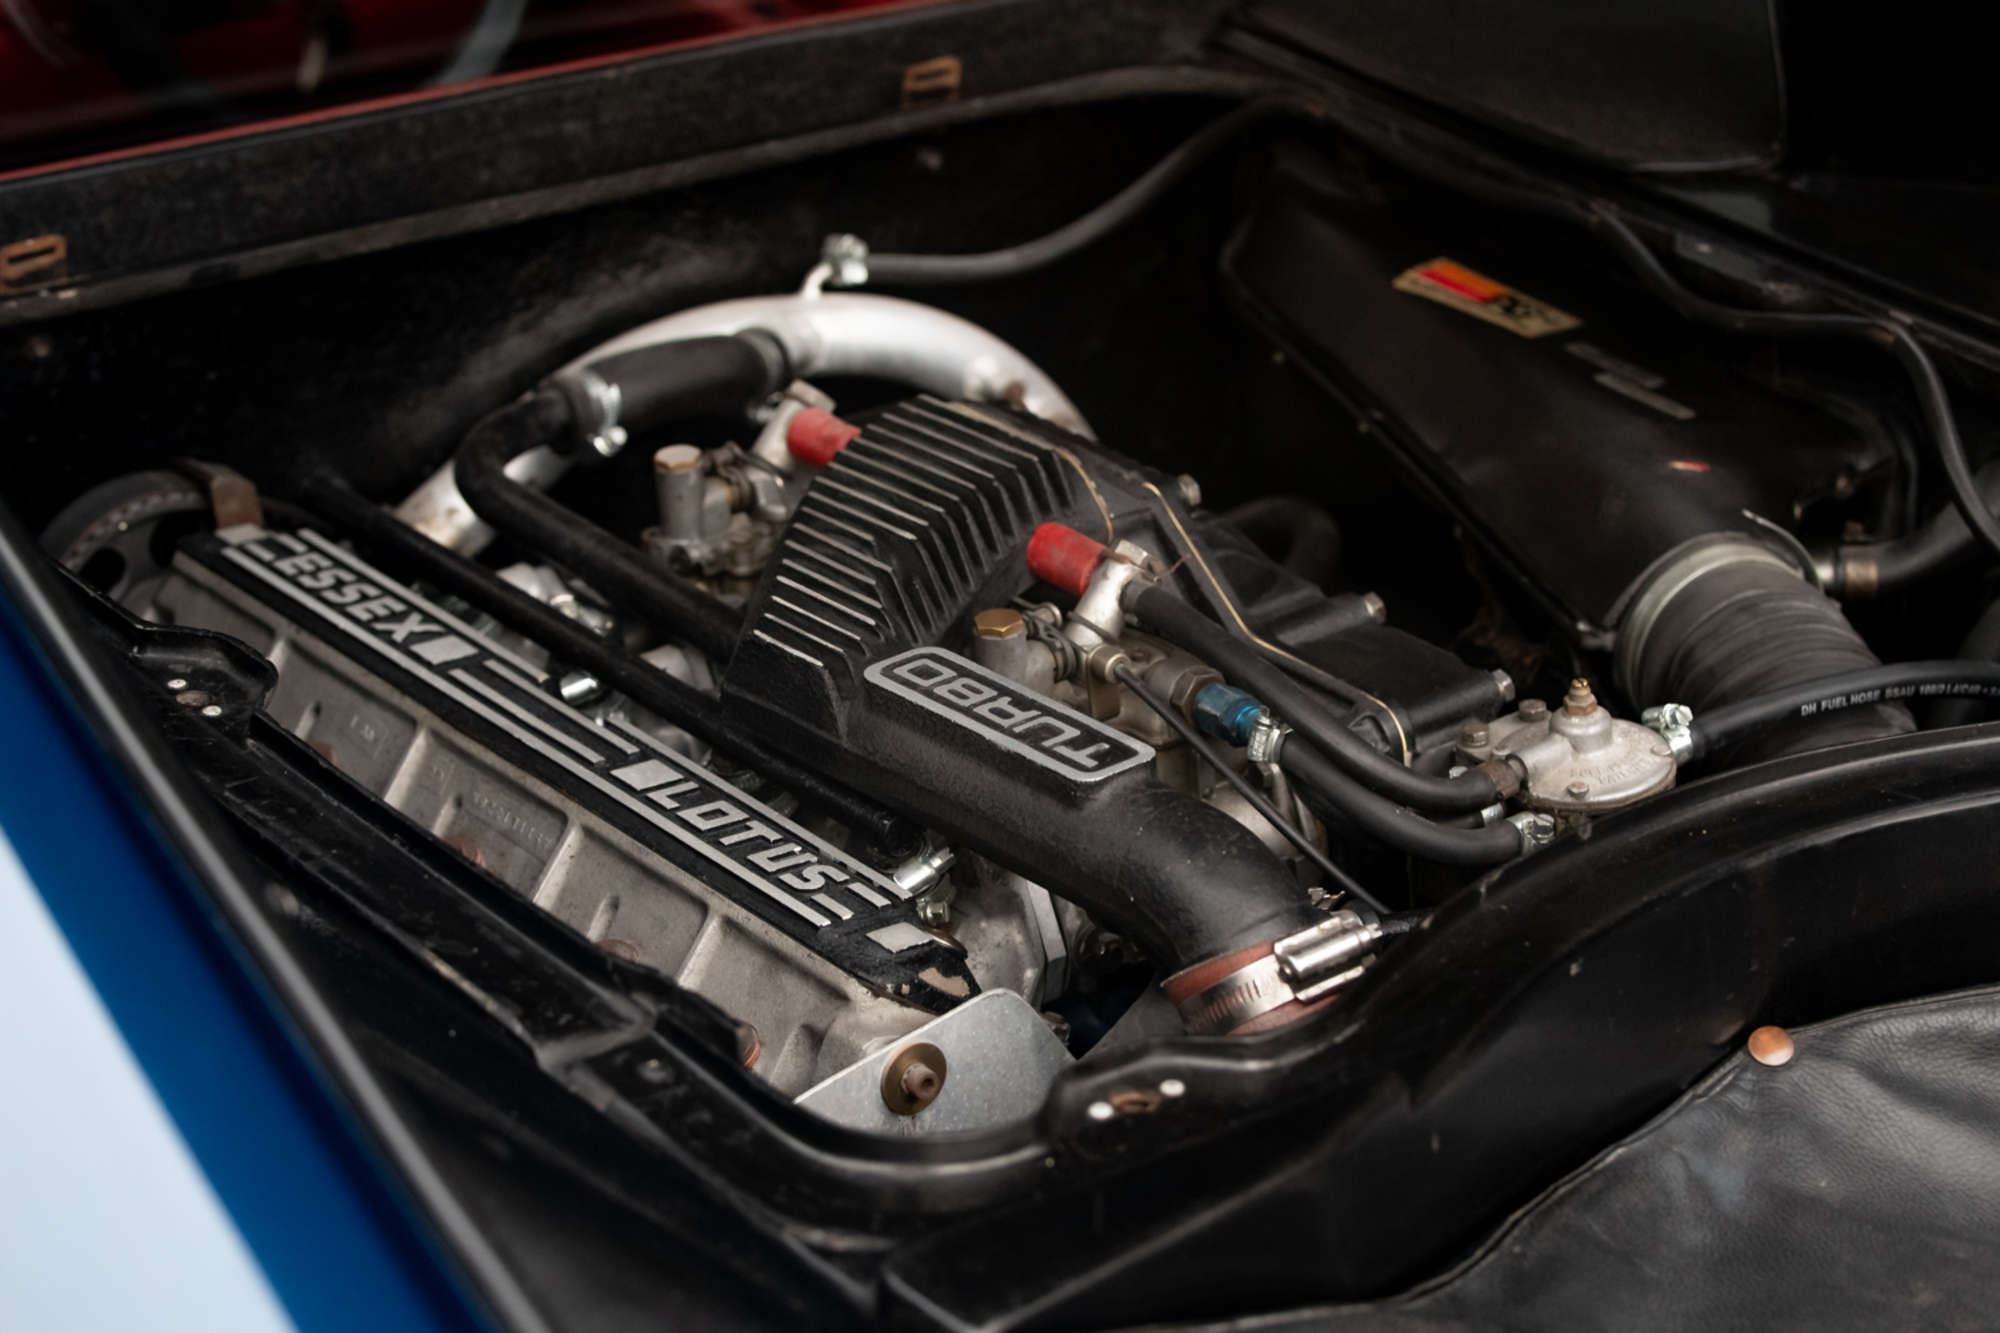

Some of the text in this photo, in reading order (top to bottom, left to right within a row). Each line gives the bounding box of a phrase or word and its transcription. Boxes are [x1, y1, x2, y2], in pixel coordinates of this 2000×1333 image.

[273, 551, 447, 644] ESSEX
[645, 780, 851, 892] LOTUS
[893, 657, 1110, 769] TURBO
[1821, 696, 1848, 712] FUEL
[1850, 689, 1881, 705] HOSE
